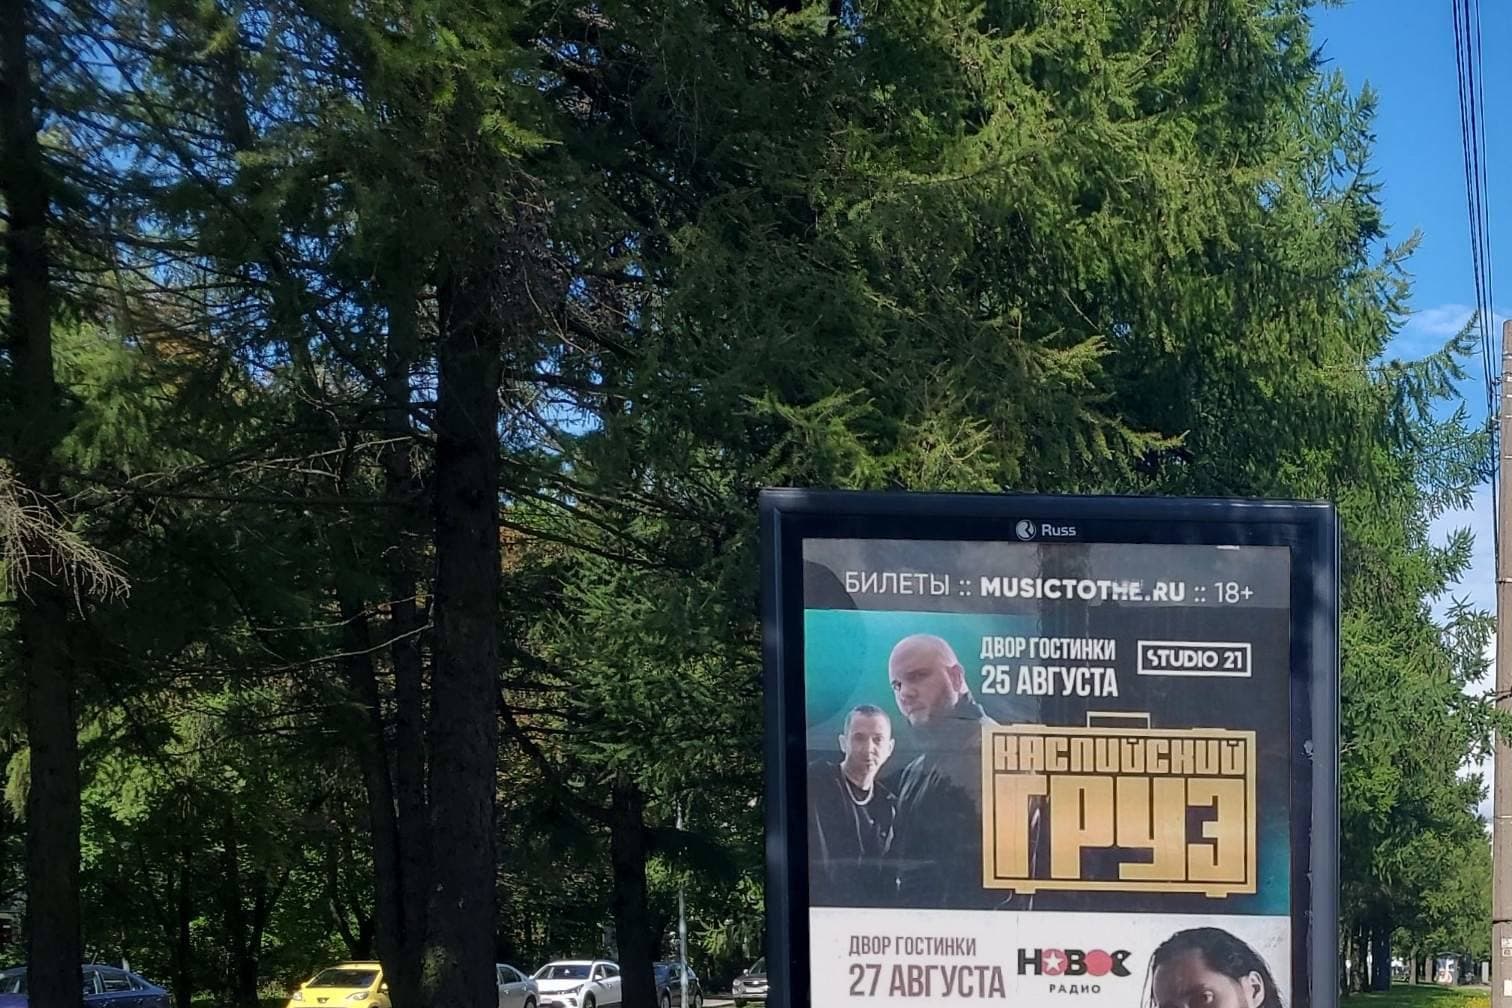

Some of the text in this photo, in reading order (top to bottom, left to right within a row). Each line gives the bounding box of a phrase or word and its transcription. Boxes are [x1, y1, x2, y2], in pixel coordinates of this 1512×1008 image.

[1041, 523, 1077, 537] Russ
[845, 571, 949, 596] БИЛЕТЫ
[980, 576, 1185, 602] MUSICTOTHE.RU
[1214, 581, 1254, 603] 18+
[980, 636, 1116, 661] ДВОР ГОСТИНКИ
[1146, 649, 1243, 669] STUDIO 21
[981, 665, 1119, 697] 25 АВГУСТА
[994, 735, 1246, 775] КАСПИЙСКИЙ
[994, 774, 1246, 883] ГРУЗ
[849, 935, 977, 957] ДВОР ГОСТИНКИ
[849, 963, 1006, 999] 27 АВГУСТА
[1049, 984, 1101, 995] РАДИО
